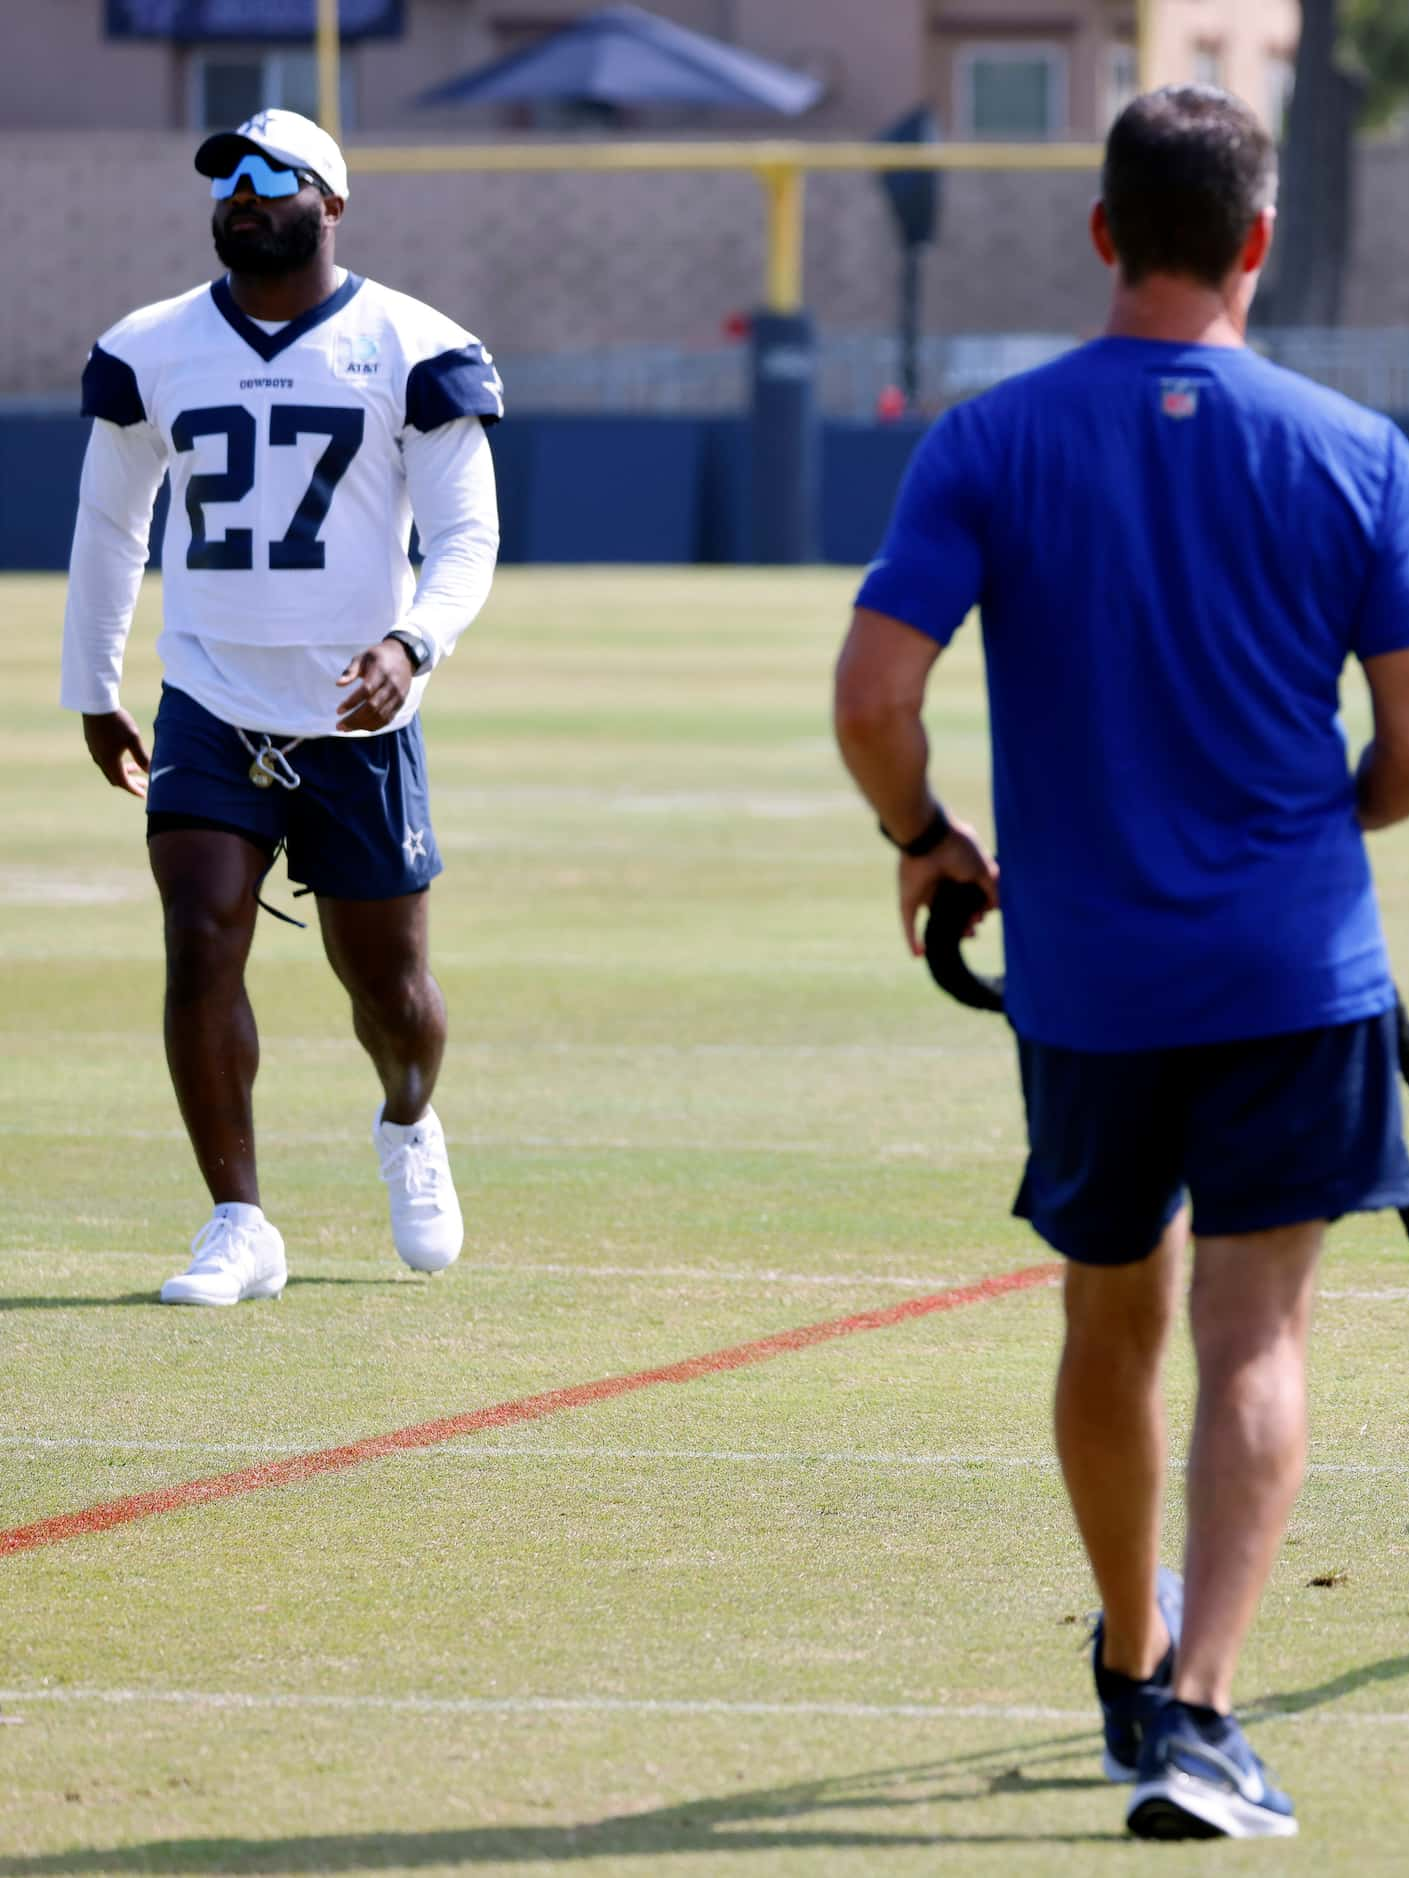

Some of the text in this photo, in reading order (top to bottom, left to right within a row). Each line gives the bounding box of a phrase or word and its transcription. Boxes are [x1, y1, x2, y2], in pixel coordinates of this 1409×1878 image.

[347, 362, 379, 374] AT&T
[239, 378, 294, 390] COWBOYS
[171, 404, 365, 570] 27
